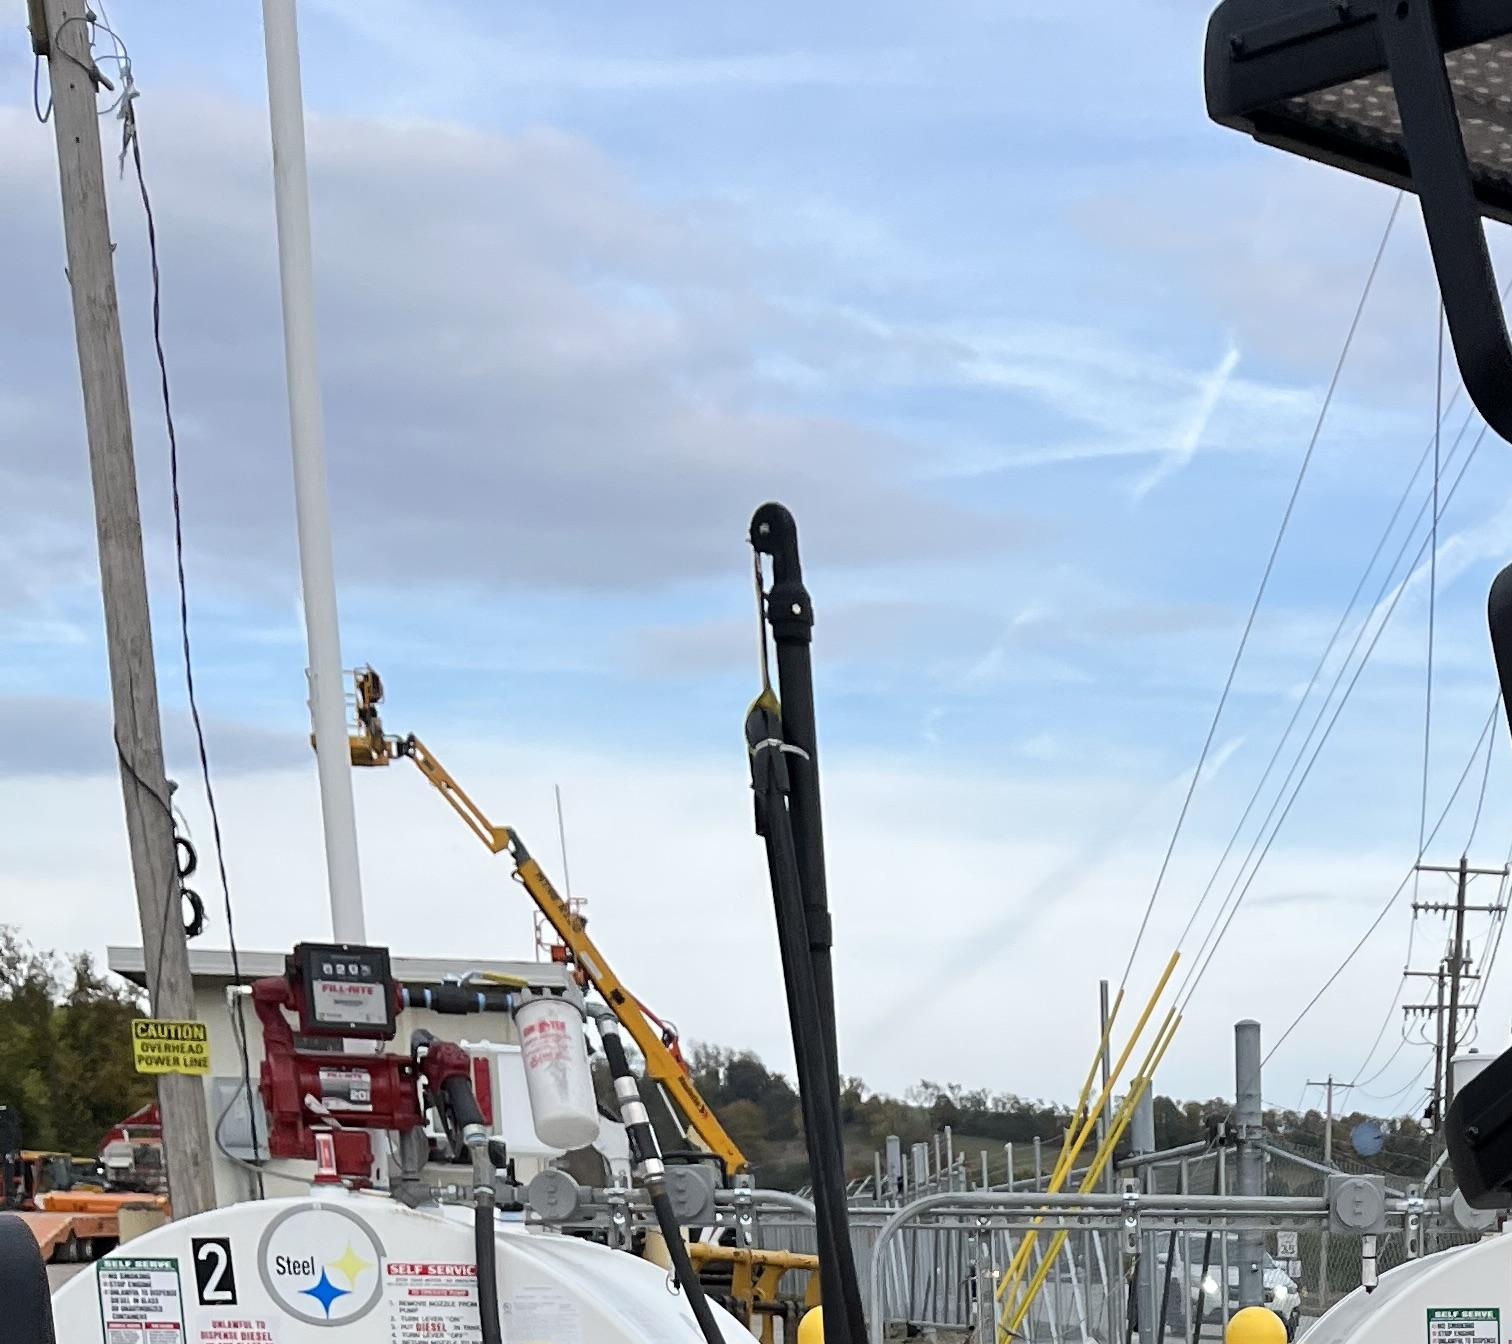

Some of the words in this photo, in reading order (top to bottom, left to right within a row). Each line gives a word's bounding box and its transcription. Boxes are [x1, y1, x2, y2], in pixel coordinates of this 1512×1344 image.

[137, 1023, 204, 1040] CAUTION
[141, 1042, 203, 1054] OVERHEAD
[137, 1055, 180, 1066] POWER
[183, 1056, 208, 1067] LINE
[198, 1242, 232, 1300] 2
[276, 1255, 315, 1275] Steel
[390, 1265, 422, 1274] SELF
[428, 1265, 477, 1275] SERVIC
[1434, 1310, 1459, 1318] SELF
[416, 1323, 447, 1332] DIESEL
[241, 1332, 272, 1341] DIESEL
